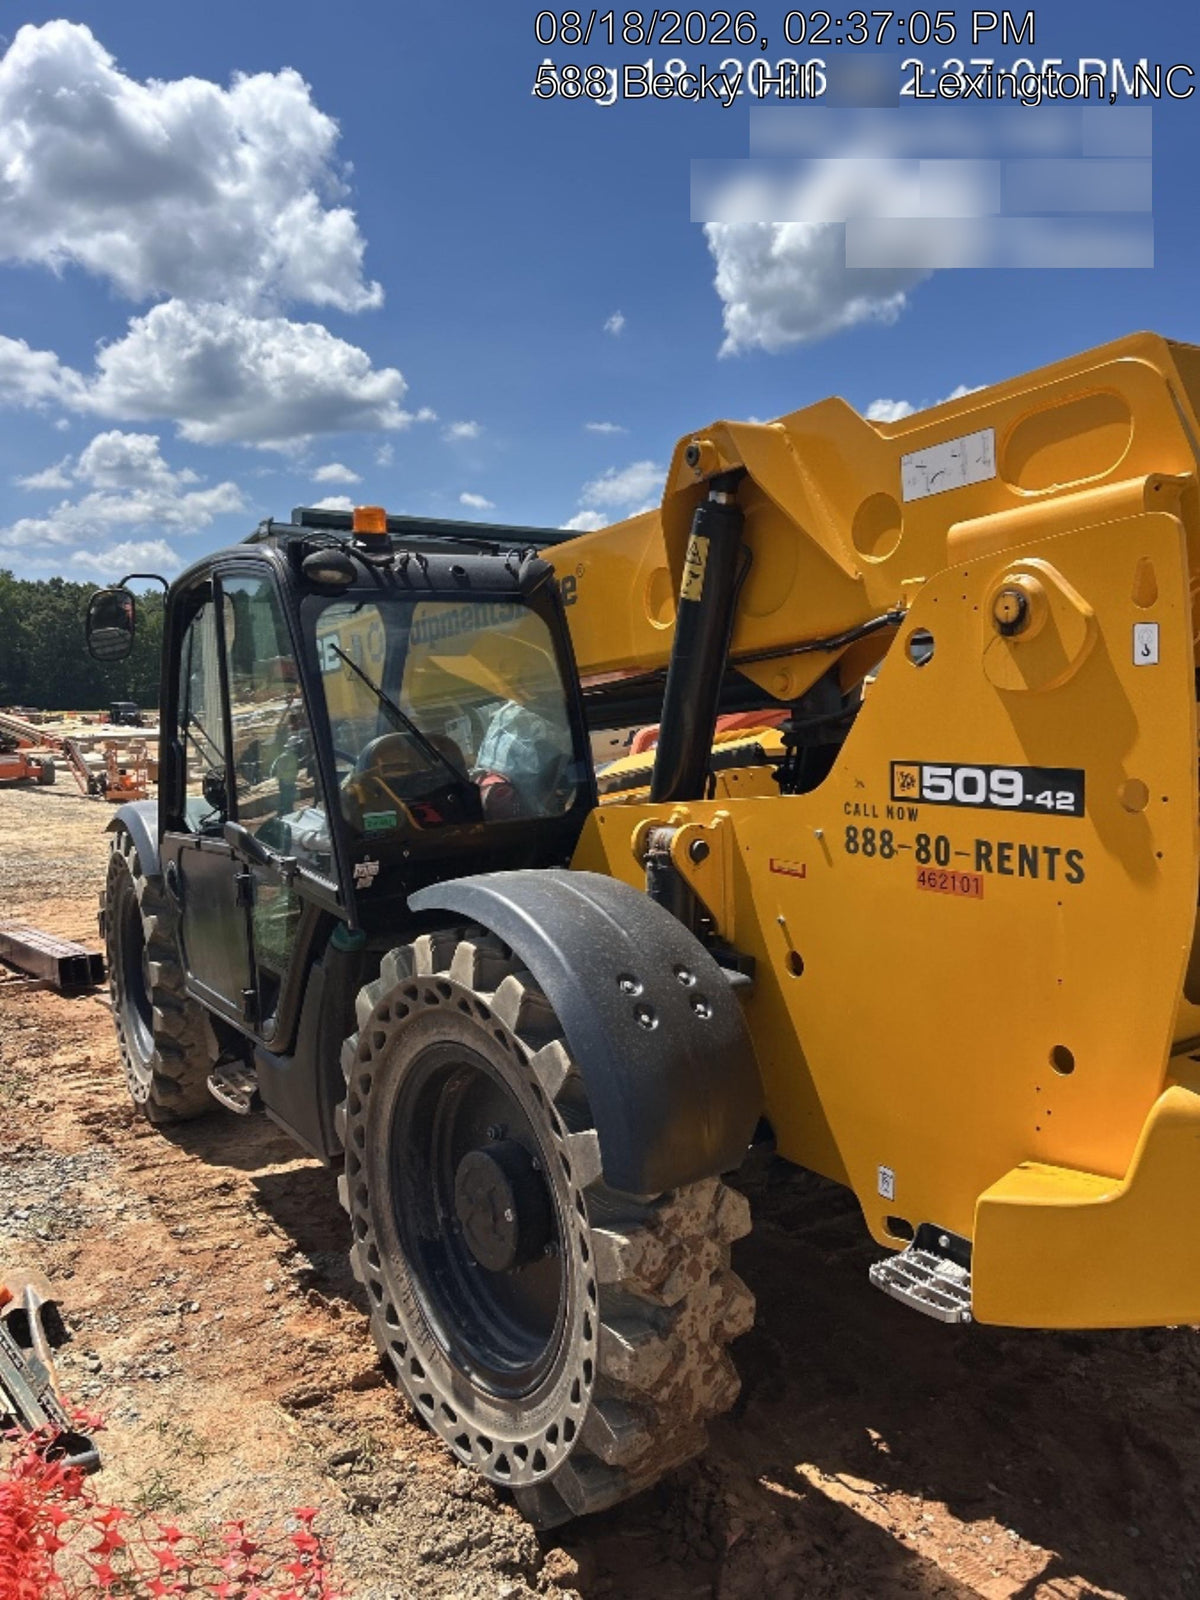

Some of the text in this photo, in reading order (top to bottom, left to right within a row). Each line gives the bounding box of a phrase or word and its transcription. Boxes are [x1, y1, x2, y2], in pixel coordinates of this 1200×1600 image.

[922, 765, 1075, 811] 509-42
[844, 802, 919, 822] CALL NOW
[845, 825, 1085, 884] 888-80-RENTS
[917, 871, 981, 895] 462101
